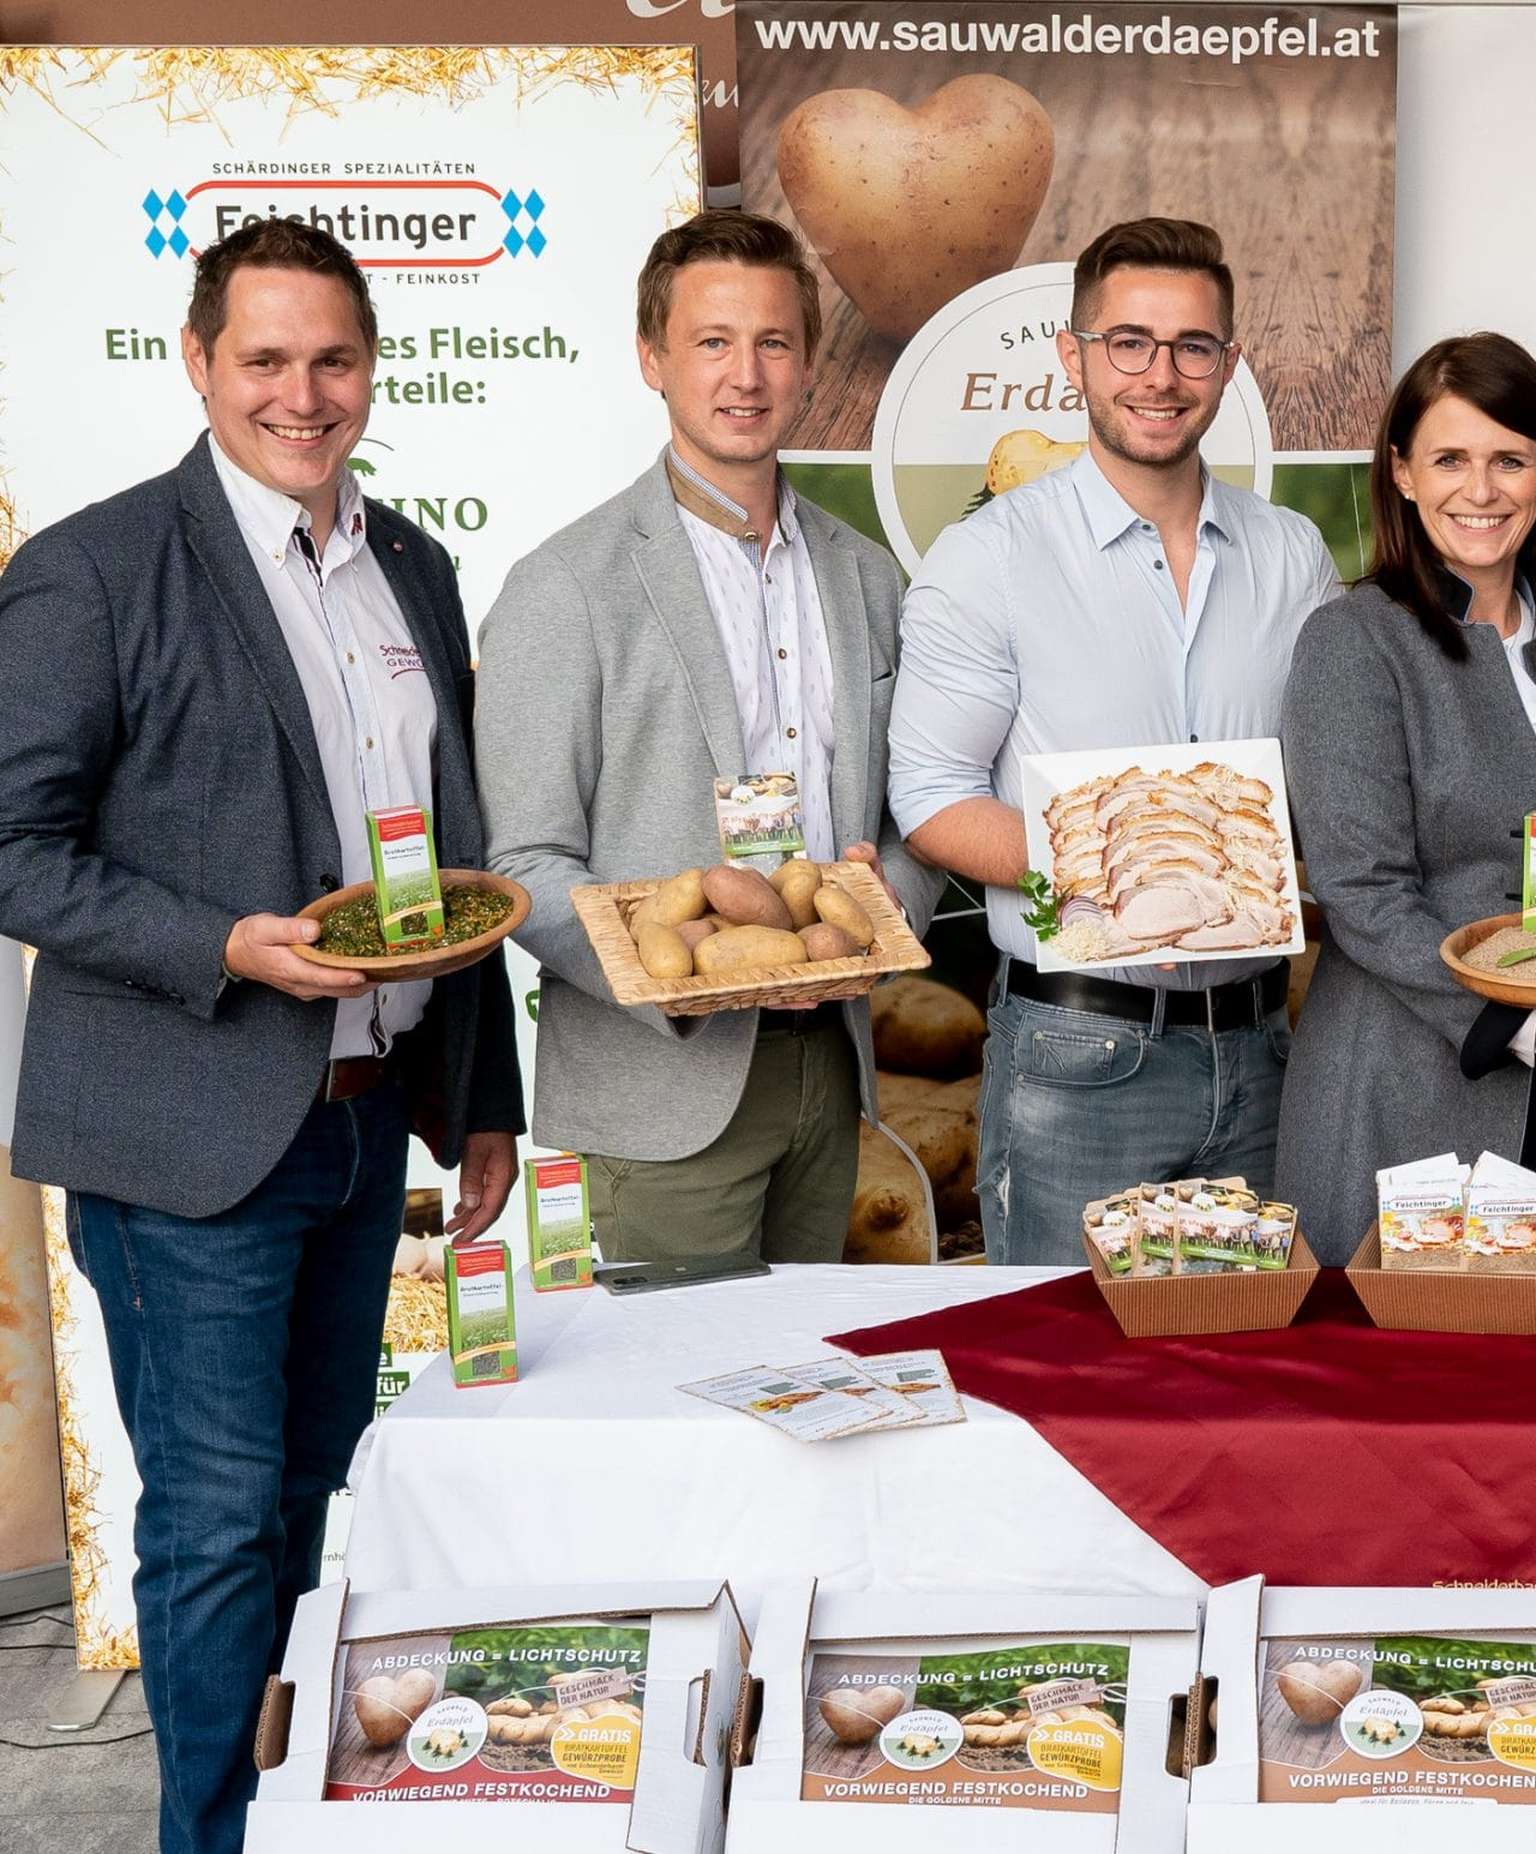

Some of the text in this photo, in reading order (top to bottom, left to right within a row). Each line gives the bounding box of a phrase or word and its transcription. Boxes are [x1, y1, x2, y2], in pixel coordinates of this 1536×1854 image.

[754, 16, 1380, 63] www.sauwalderdaepfel.at
[212, 160, 476, 175] SCHÄRDINGER SPEZIALITÄTEN
[396, 273, 481, 285] FEINKOST
[105, 328, 167, 361] Ein
[429, 326, 580, 364] Fleisch,
[372, 372, 487, 404] rteile:
[372, 1650, 486, 1670] ABDECKUNG
[509, 1648, 642, 1663] LICHTSCHUTZ
[1295, 1646, 1412, 1665] ABDECKUNG
[838, 1673, 956, 1685] ABDECKUNG
[979, 1662, 1109, 1681] LICHTSCHUTZ
[578, 1729, 632, 1743] GRATIS
[1053, 1729, 1105, 1748] GRATIS
[1289, 1771, 1409, 1788] VORWIEGEND
[352, 1781, 610, 1803] VORWIEGEND FESTKOCHEND
[824, 1782, 1088, 1798] VORWIEGEND FESTKOCHEND
[1372, 1786, 1388, 1795] DIE
[1436, 1787, 1464, 1795] MITTE
[908, 1796, 924, 1804] DIE
[973, 1797, 1001, 1805] MITTE
